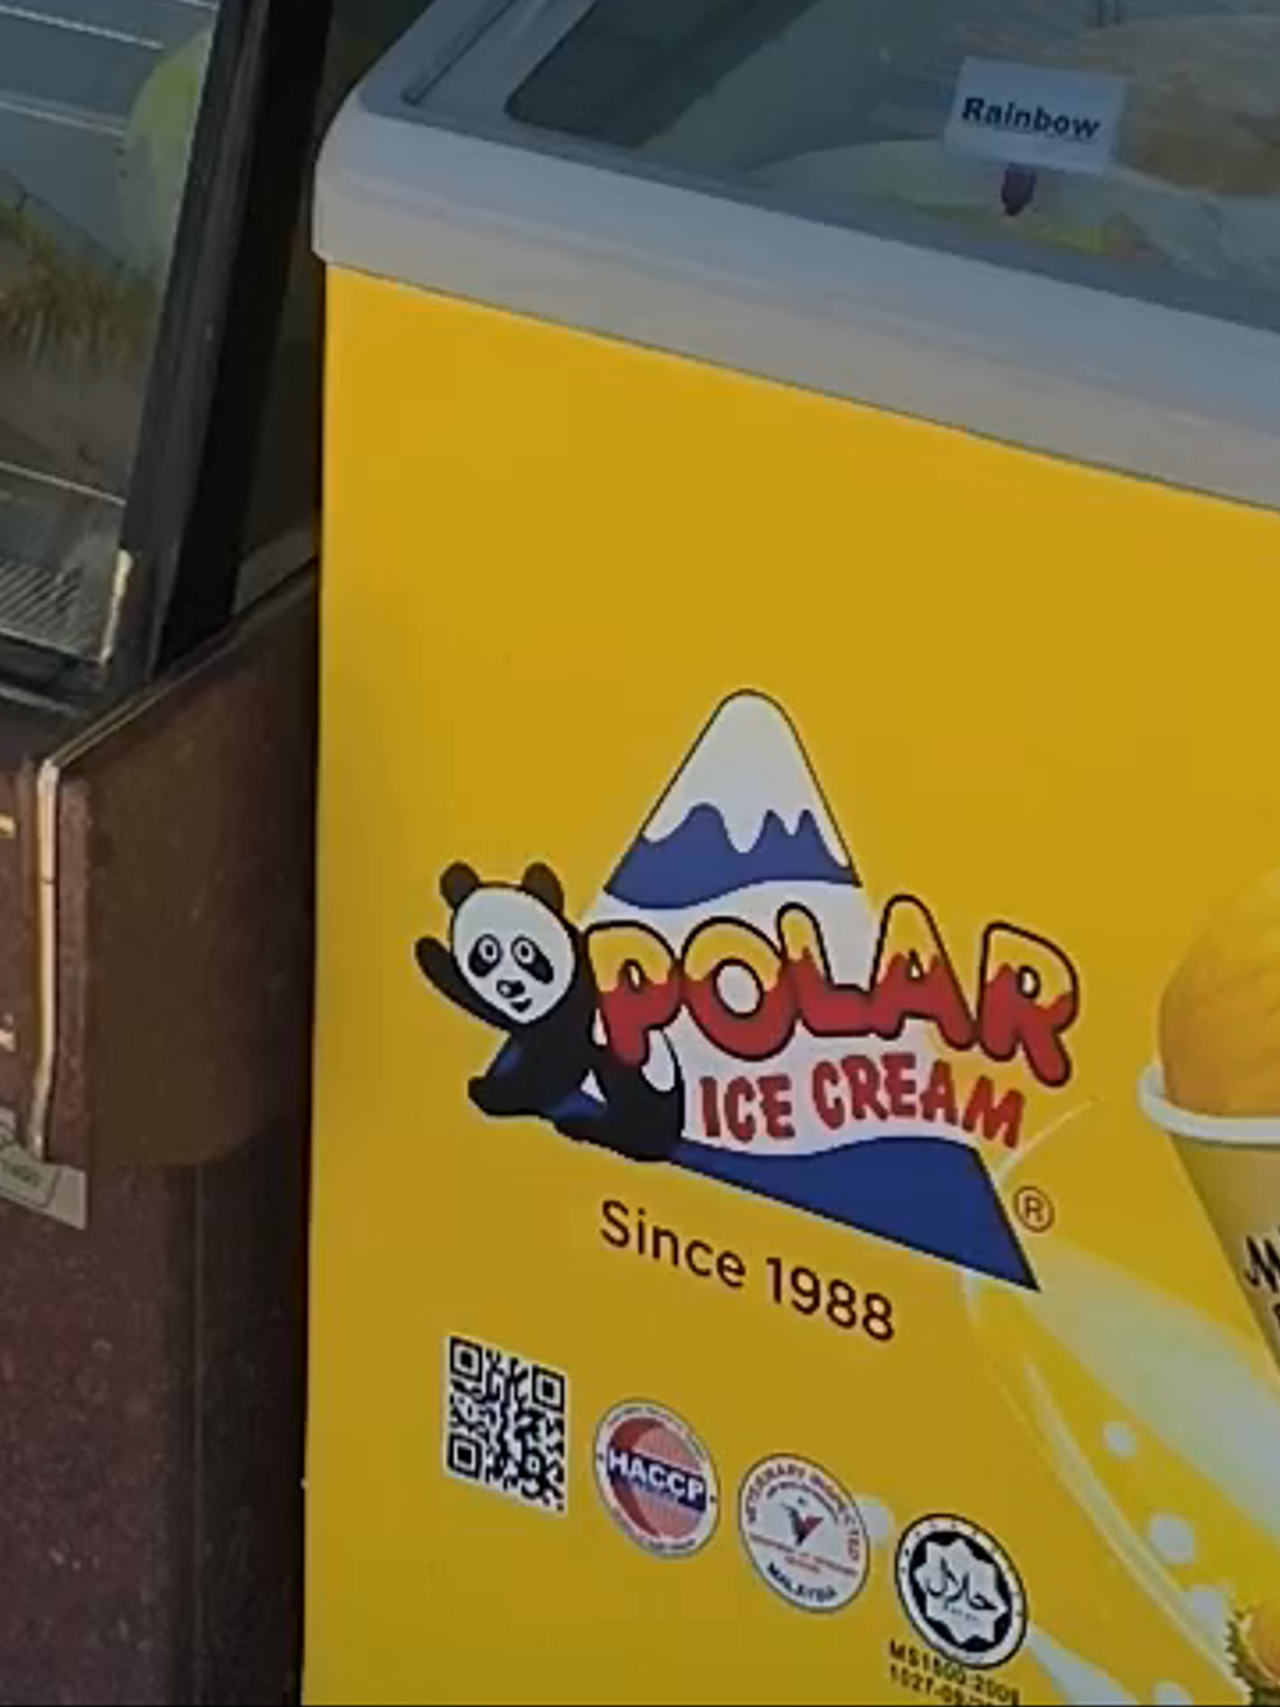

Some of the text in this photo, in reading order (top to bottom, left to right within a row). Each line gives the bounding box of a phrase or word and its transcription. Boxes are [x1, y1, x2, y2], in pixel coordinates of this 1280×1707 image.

[961, 95, 1102, 142] Rainbow
[582, 893, 1080, 1087] POLAR
[699, 1053, 1025, 1148] ICE CREAM
[601, 1198, 895, 1342] Since 1988
[607, 1448, 705, 1502] HACCP
